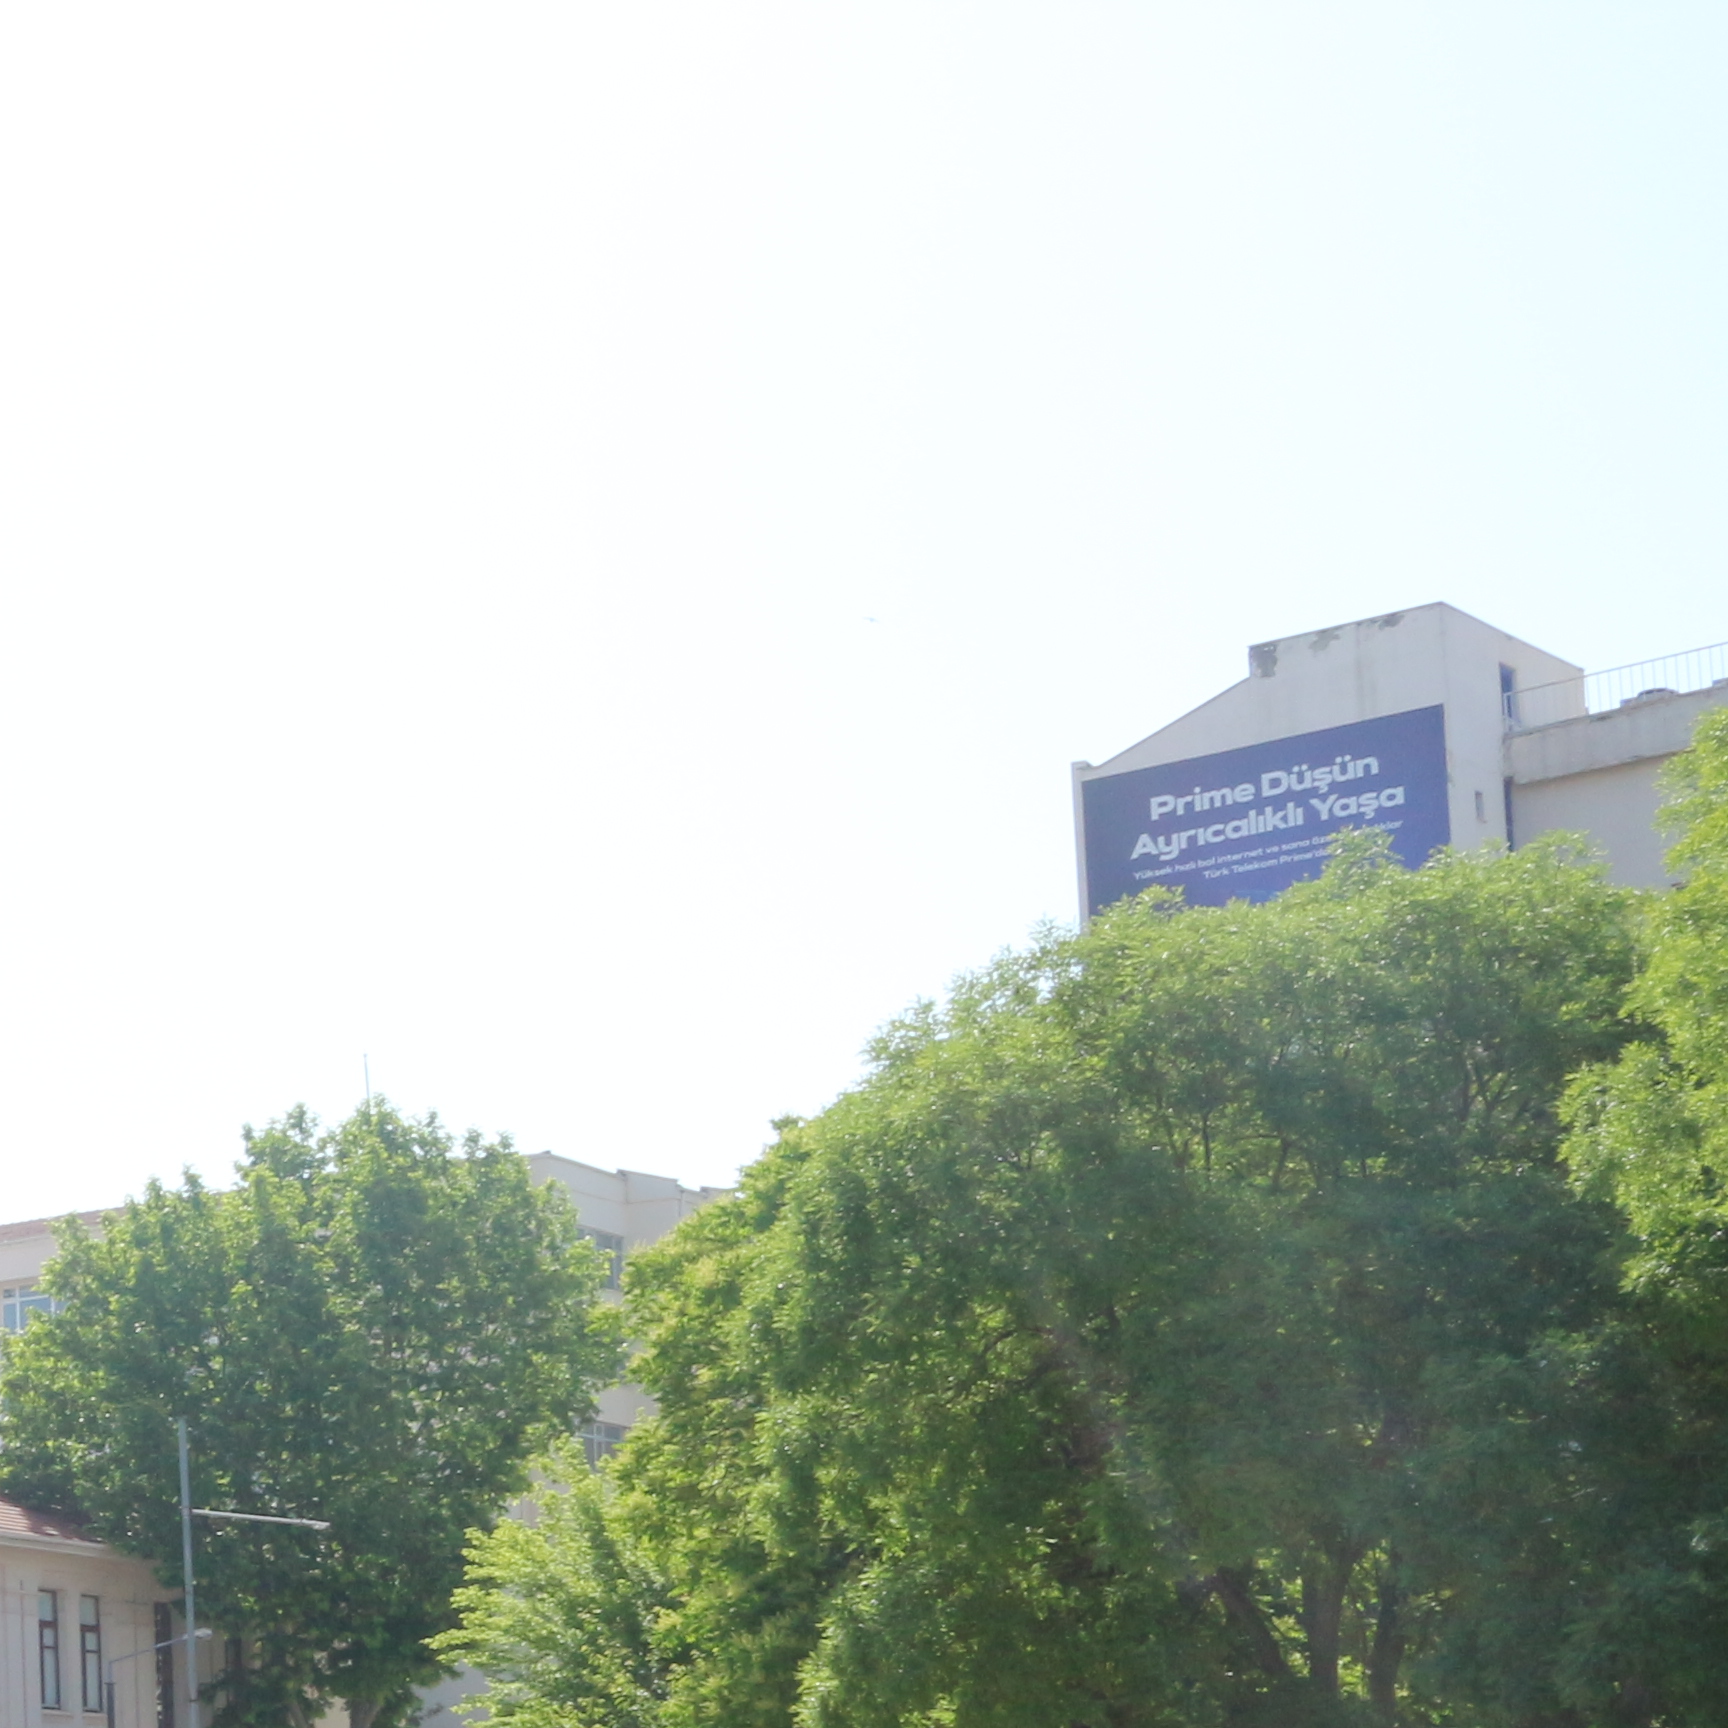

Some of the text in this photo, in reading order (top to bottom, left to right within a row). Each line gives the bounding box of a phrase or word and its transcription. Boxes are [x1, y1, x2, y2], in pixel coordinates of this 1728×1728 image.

[1150, 754, 1380, 821] Prime Düşün
[1130, 786, 1405, 861] Ayrıcalıklı Yaşa
[1203, 867, 1230, 880] Türk
[1232, 858, 1278, 874] Telekom
